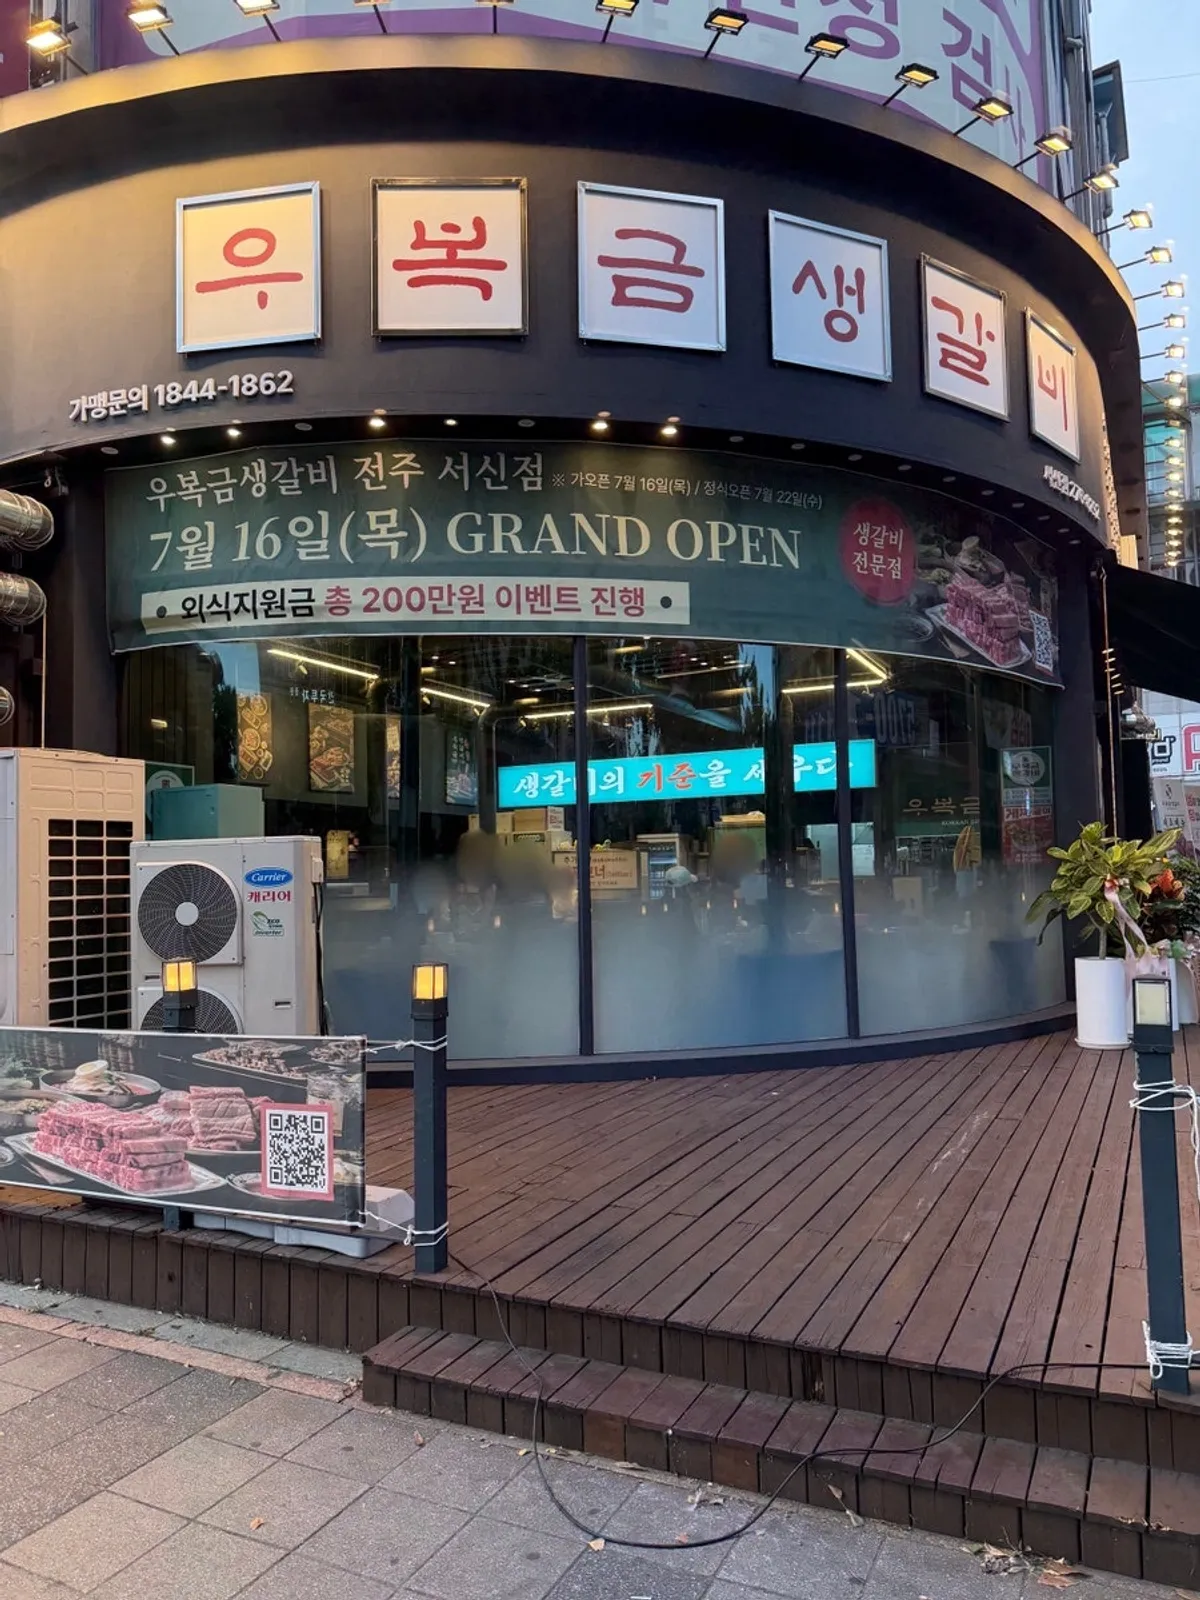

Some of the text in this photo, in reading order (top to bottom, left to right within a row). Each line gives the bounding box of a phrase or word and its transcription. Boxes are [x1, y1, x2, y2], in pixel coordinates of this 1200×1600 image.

[69, 370, 294, 421] 가맹문의 1844-1862
[146, 451, 543, 512] 우복금생갈비 전주 서신점
[570, 473, 610, 489] 가오픈
[614, 475, 636, 492] 7월
[639, 477, 691, 497] 16일(목)
[703, 480, 752, 499] 정식오픈
[754, 488, 773, 504] 7월
[776, 490, 822, 510] 22일(수)
[149, 506, 800, 572] 7월 16일(목) GRAND OPEN
[852, 520, 905, 553] 생갈비
[852, 551, 904, 580] 전문점
[180, 583, 646, 624] 외식지원금 총 200만원 이벤트 진행
[513, 765, 624, 799] 생갈의
[636, 758, 732, 793] 기준을
[246, 890, 292, 903] 캐리어
[251, 872, 287, 882] Carrier
